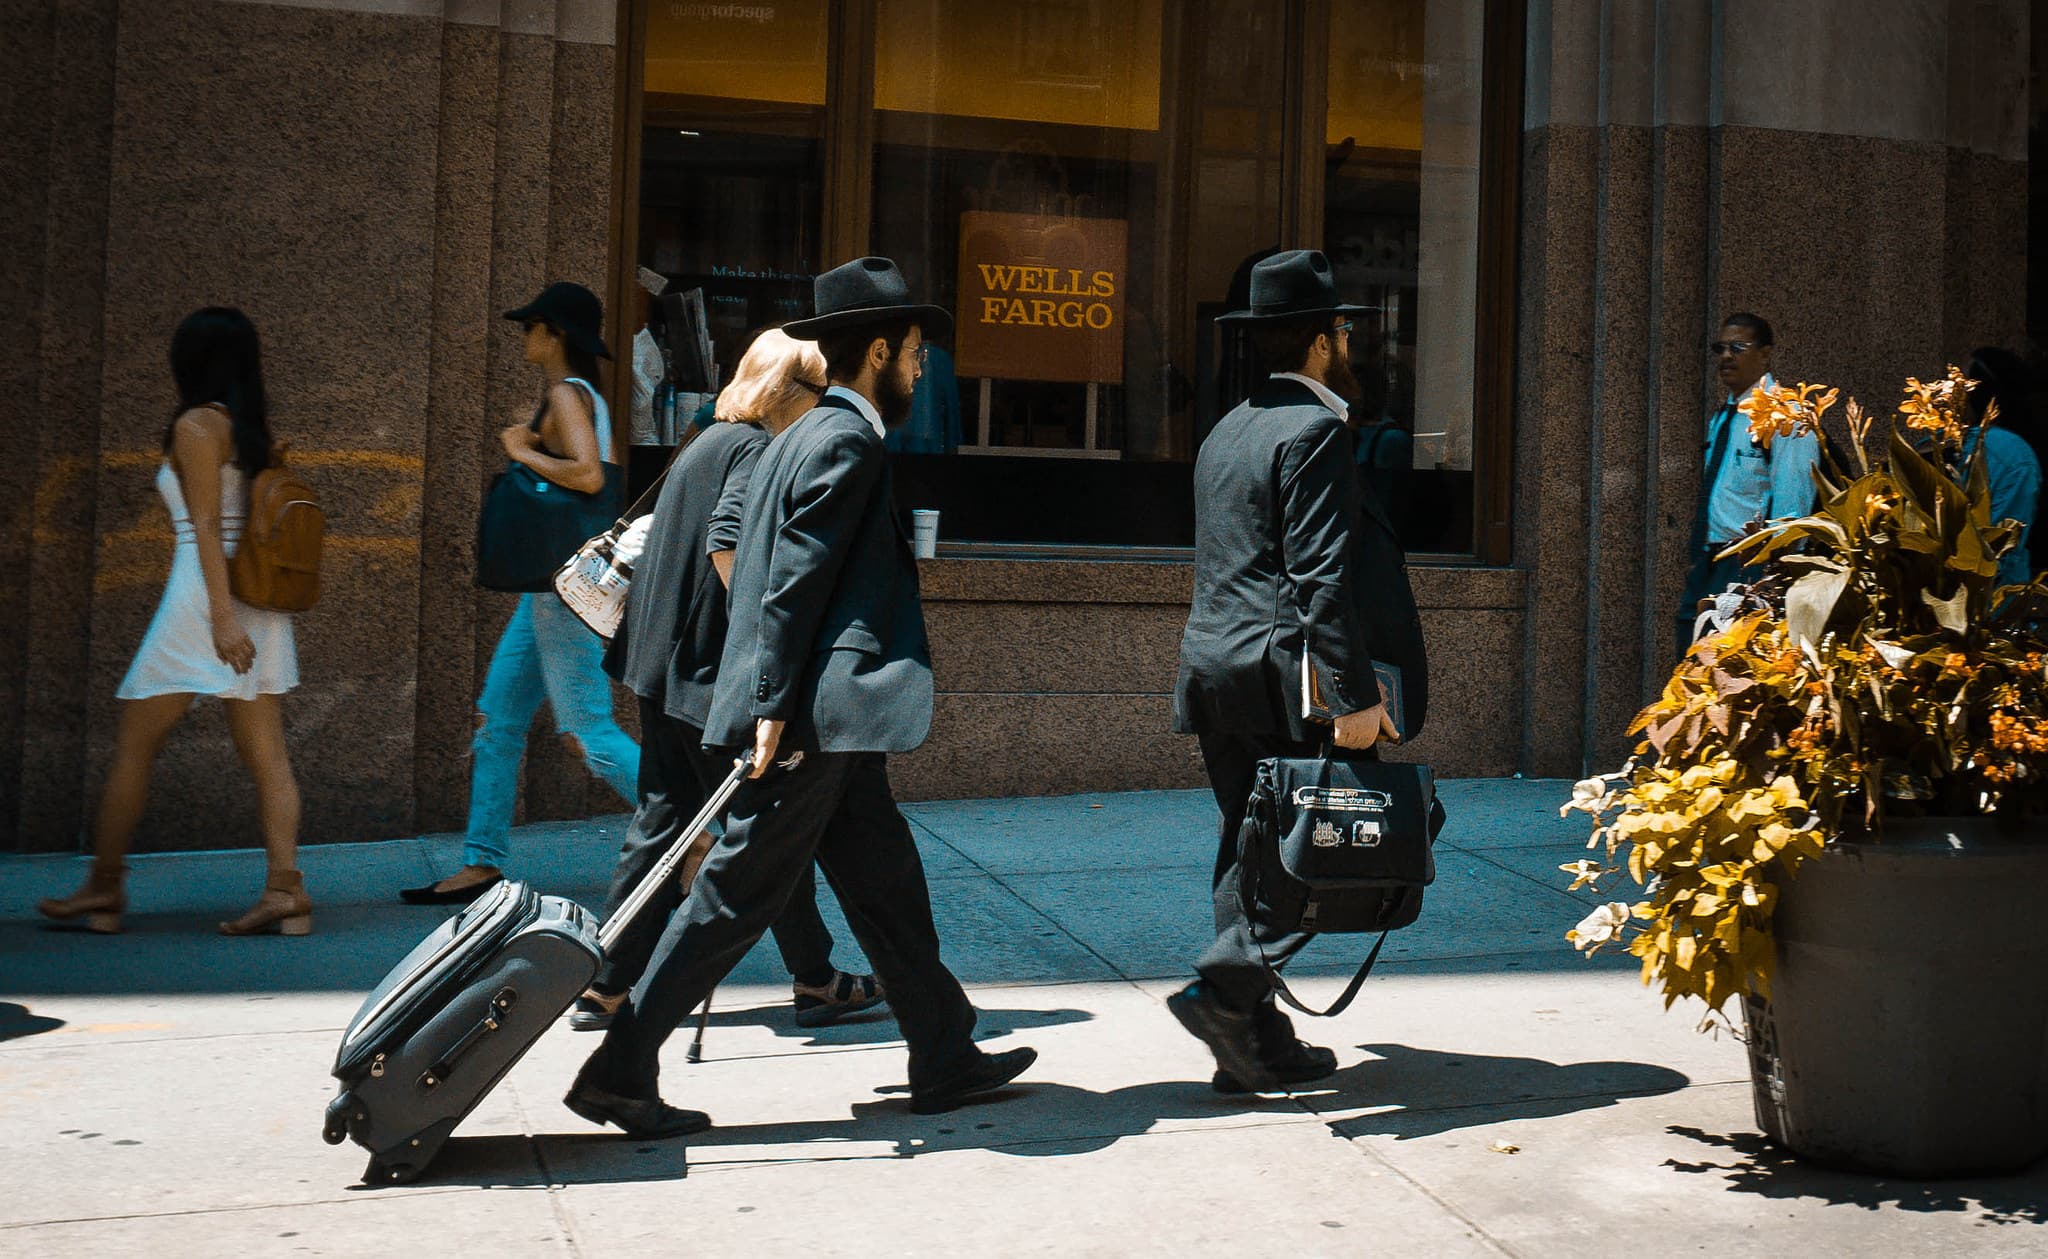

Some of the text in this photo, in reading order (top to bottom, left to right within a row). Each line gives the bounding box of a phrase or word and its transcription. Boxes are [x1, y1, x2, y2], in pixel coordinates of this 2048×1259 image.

[712, 264, 757, 279] Make
[977, 264, 1115, 297] WELLS
[980, 297, 1113, 329] FARGO
